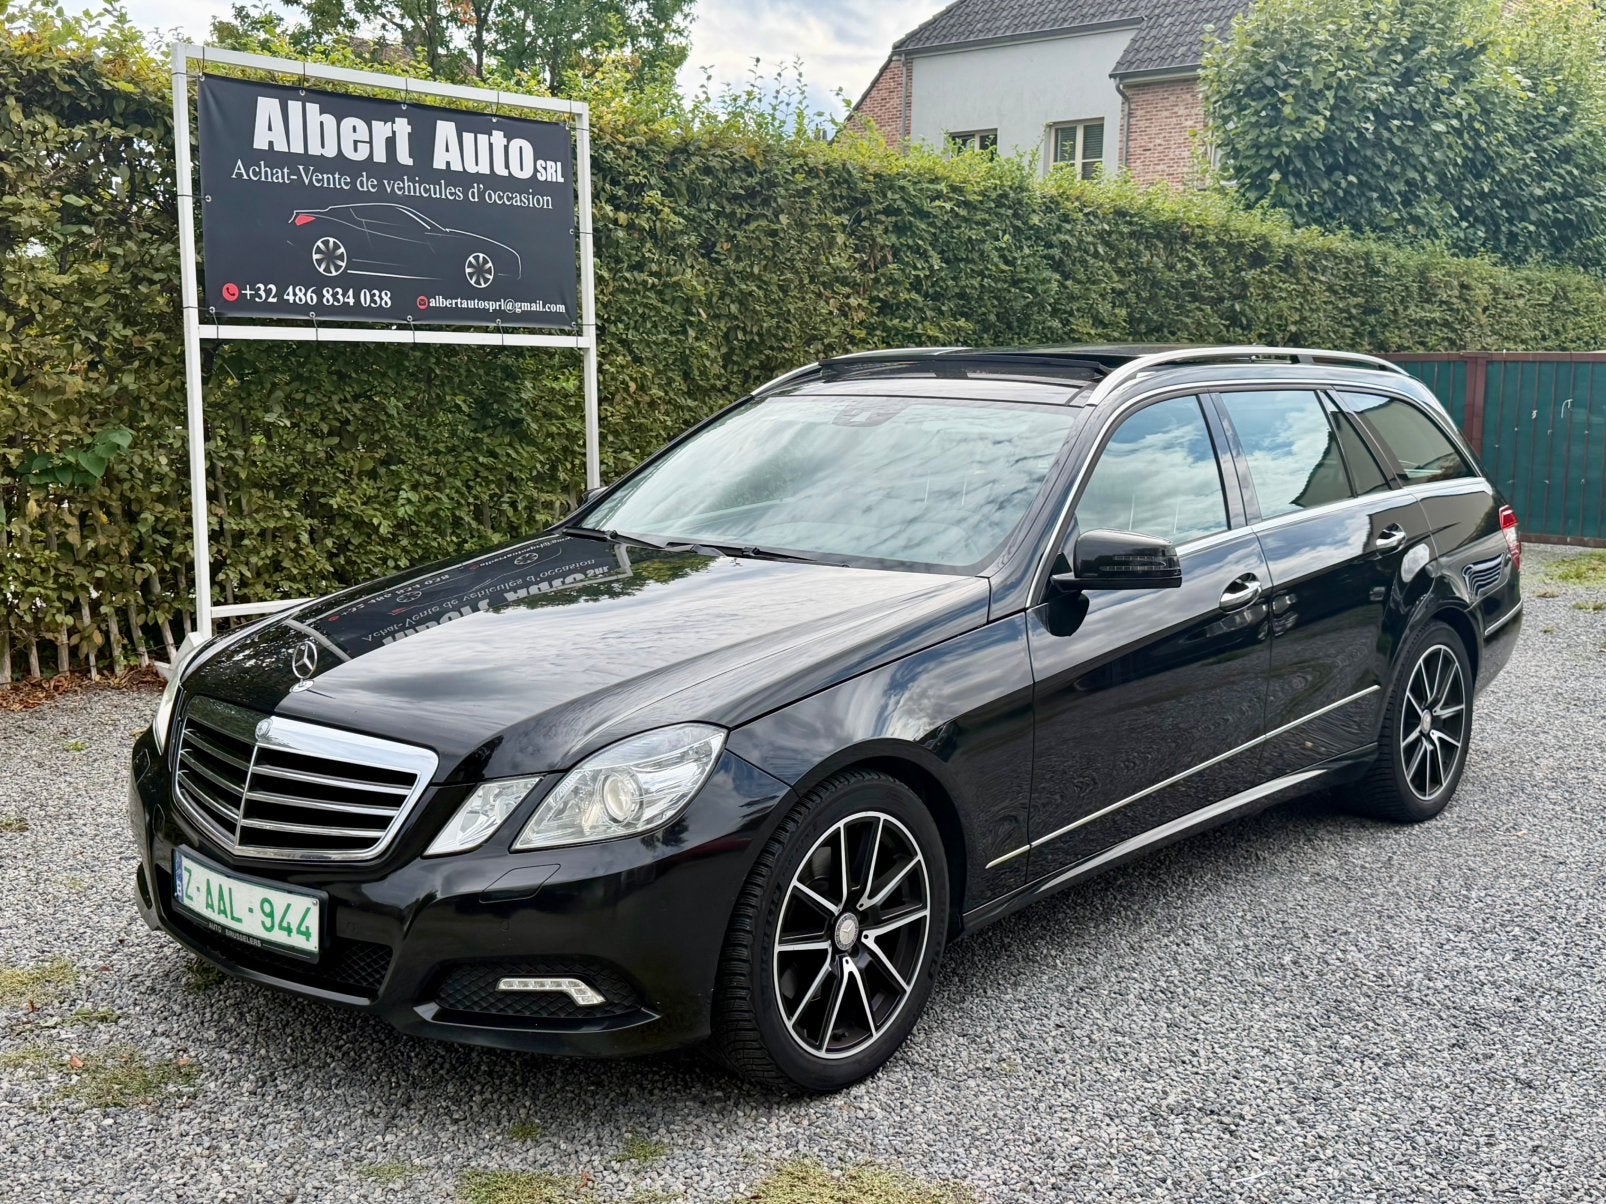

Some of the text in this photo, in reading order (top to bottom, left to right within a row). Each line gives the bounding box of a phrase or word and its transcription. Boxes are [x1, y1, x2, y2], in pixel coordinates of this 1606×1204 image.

[252, 96, 565, 183] Albert Auto SRL
[231, 158, 553, 209] Achat-Vente de vehicules d'occasion
[241, 283, 392, 308] +32 486 834 038
[429, 295, 566, 313] albertautosprl@gmail.com
[184, 866, 312, 942] Z-AAL-944
